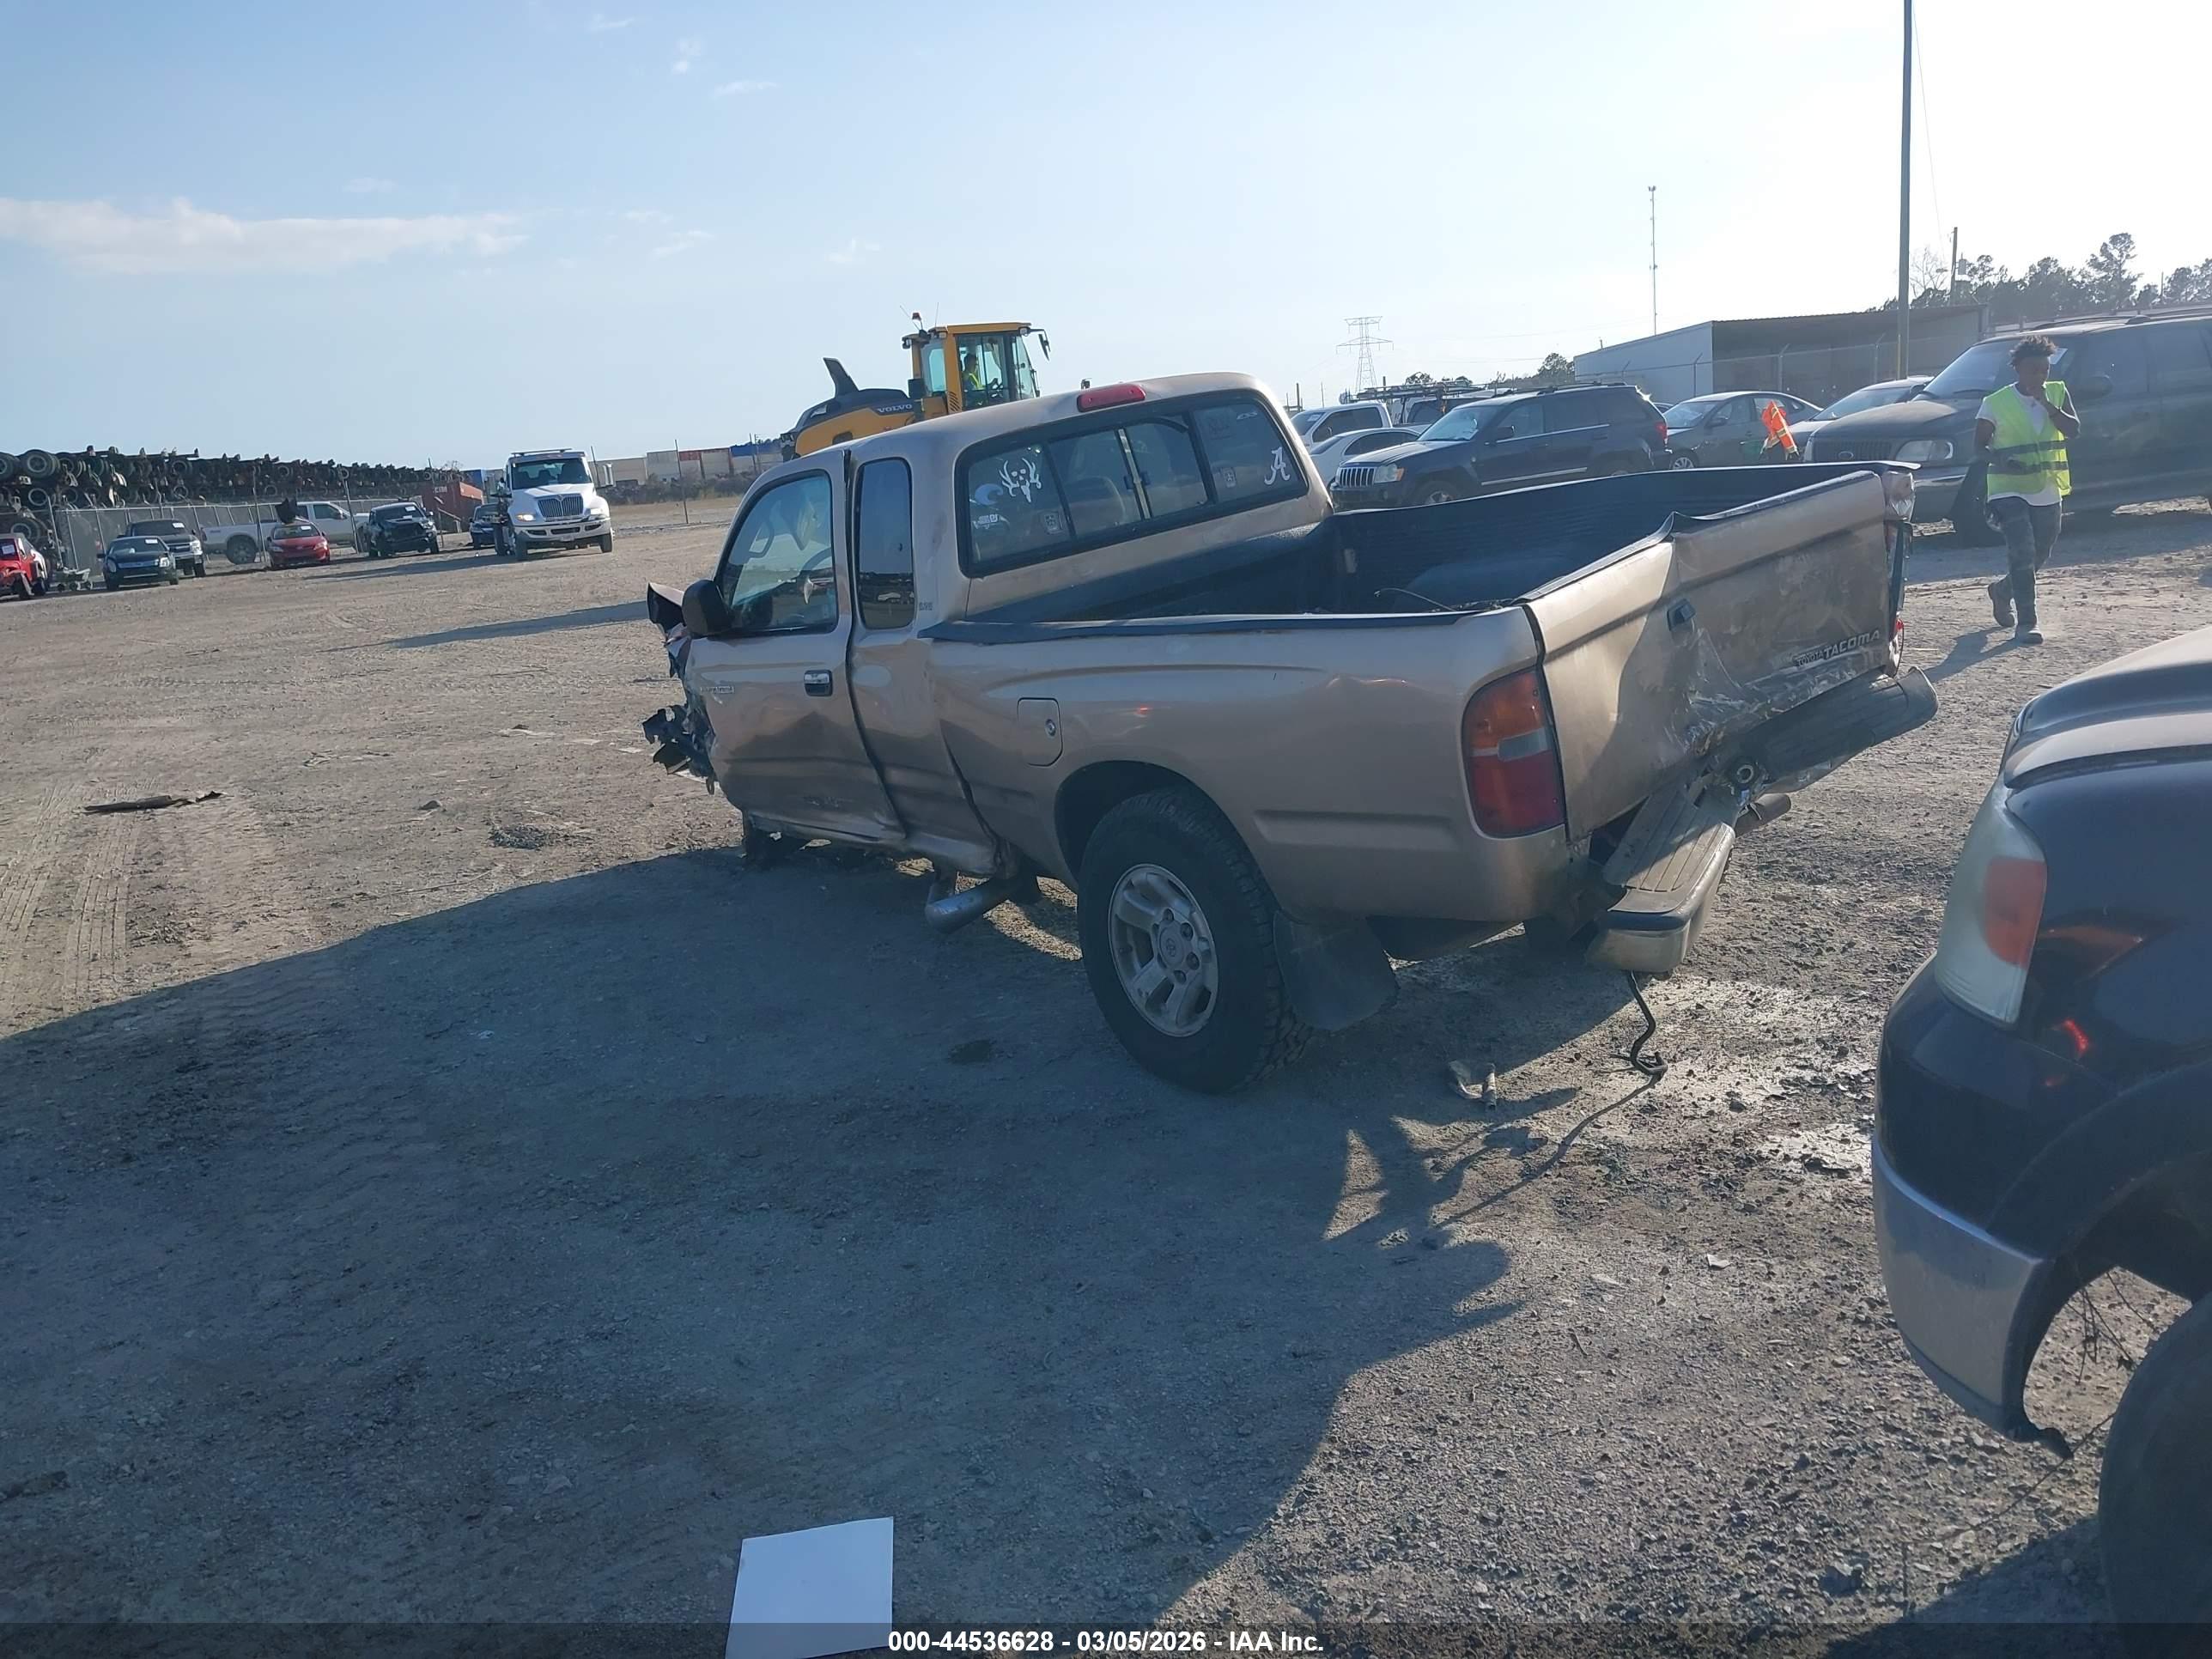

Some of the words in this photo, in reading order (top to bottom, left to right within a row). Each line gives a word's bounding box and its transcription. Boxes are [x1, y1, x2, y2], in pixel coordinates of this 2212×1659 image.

[877, 404, 913, 413] VOLVO
[1264, 447, 1291, 485] A
[1796, 651, 1825, 666] TOYOTA
[1825, 629, 1881, 659] TACOMA
